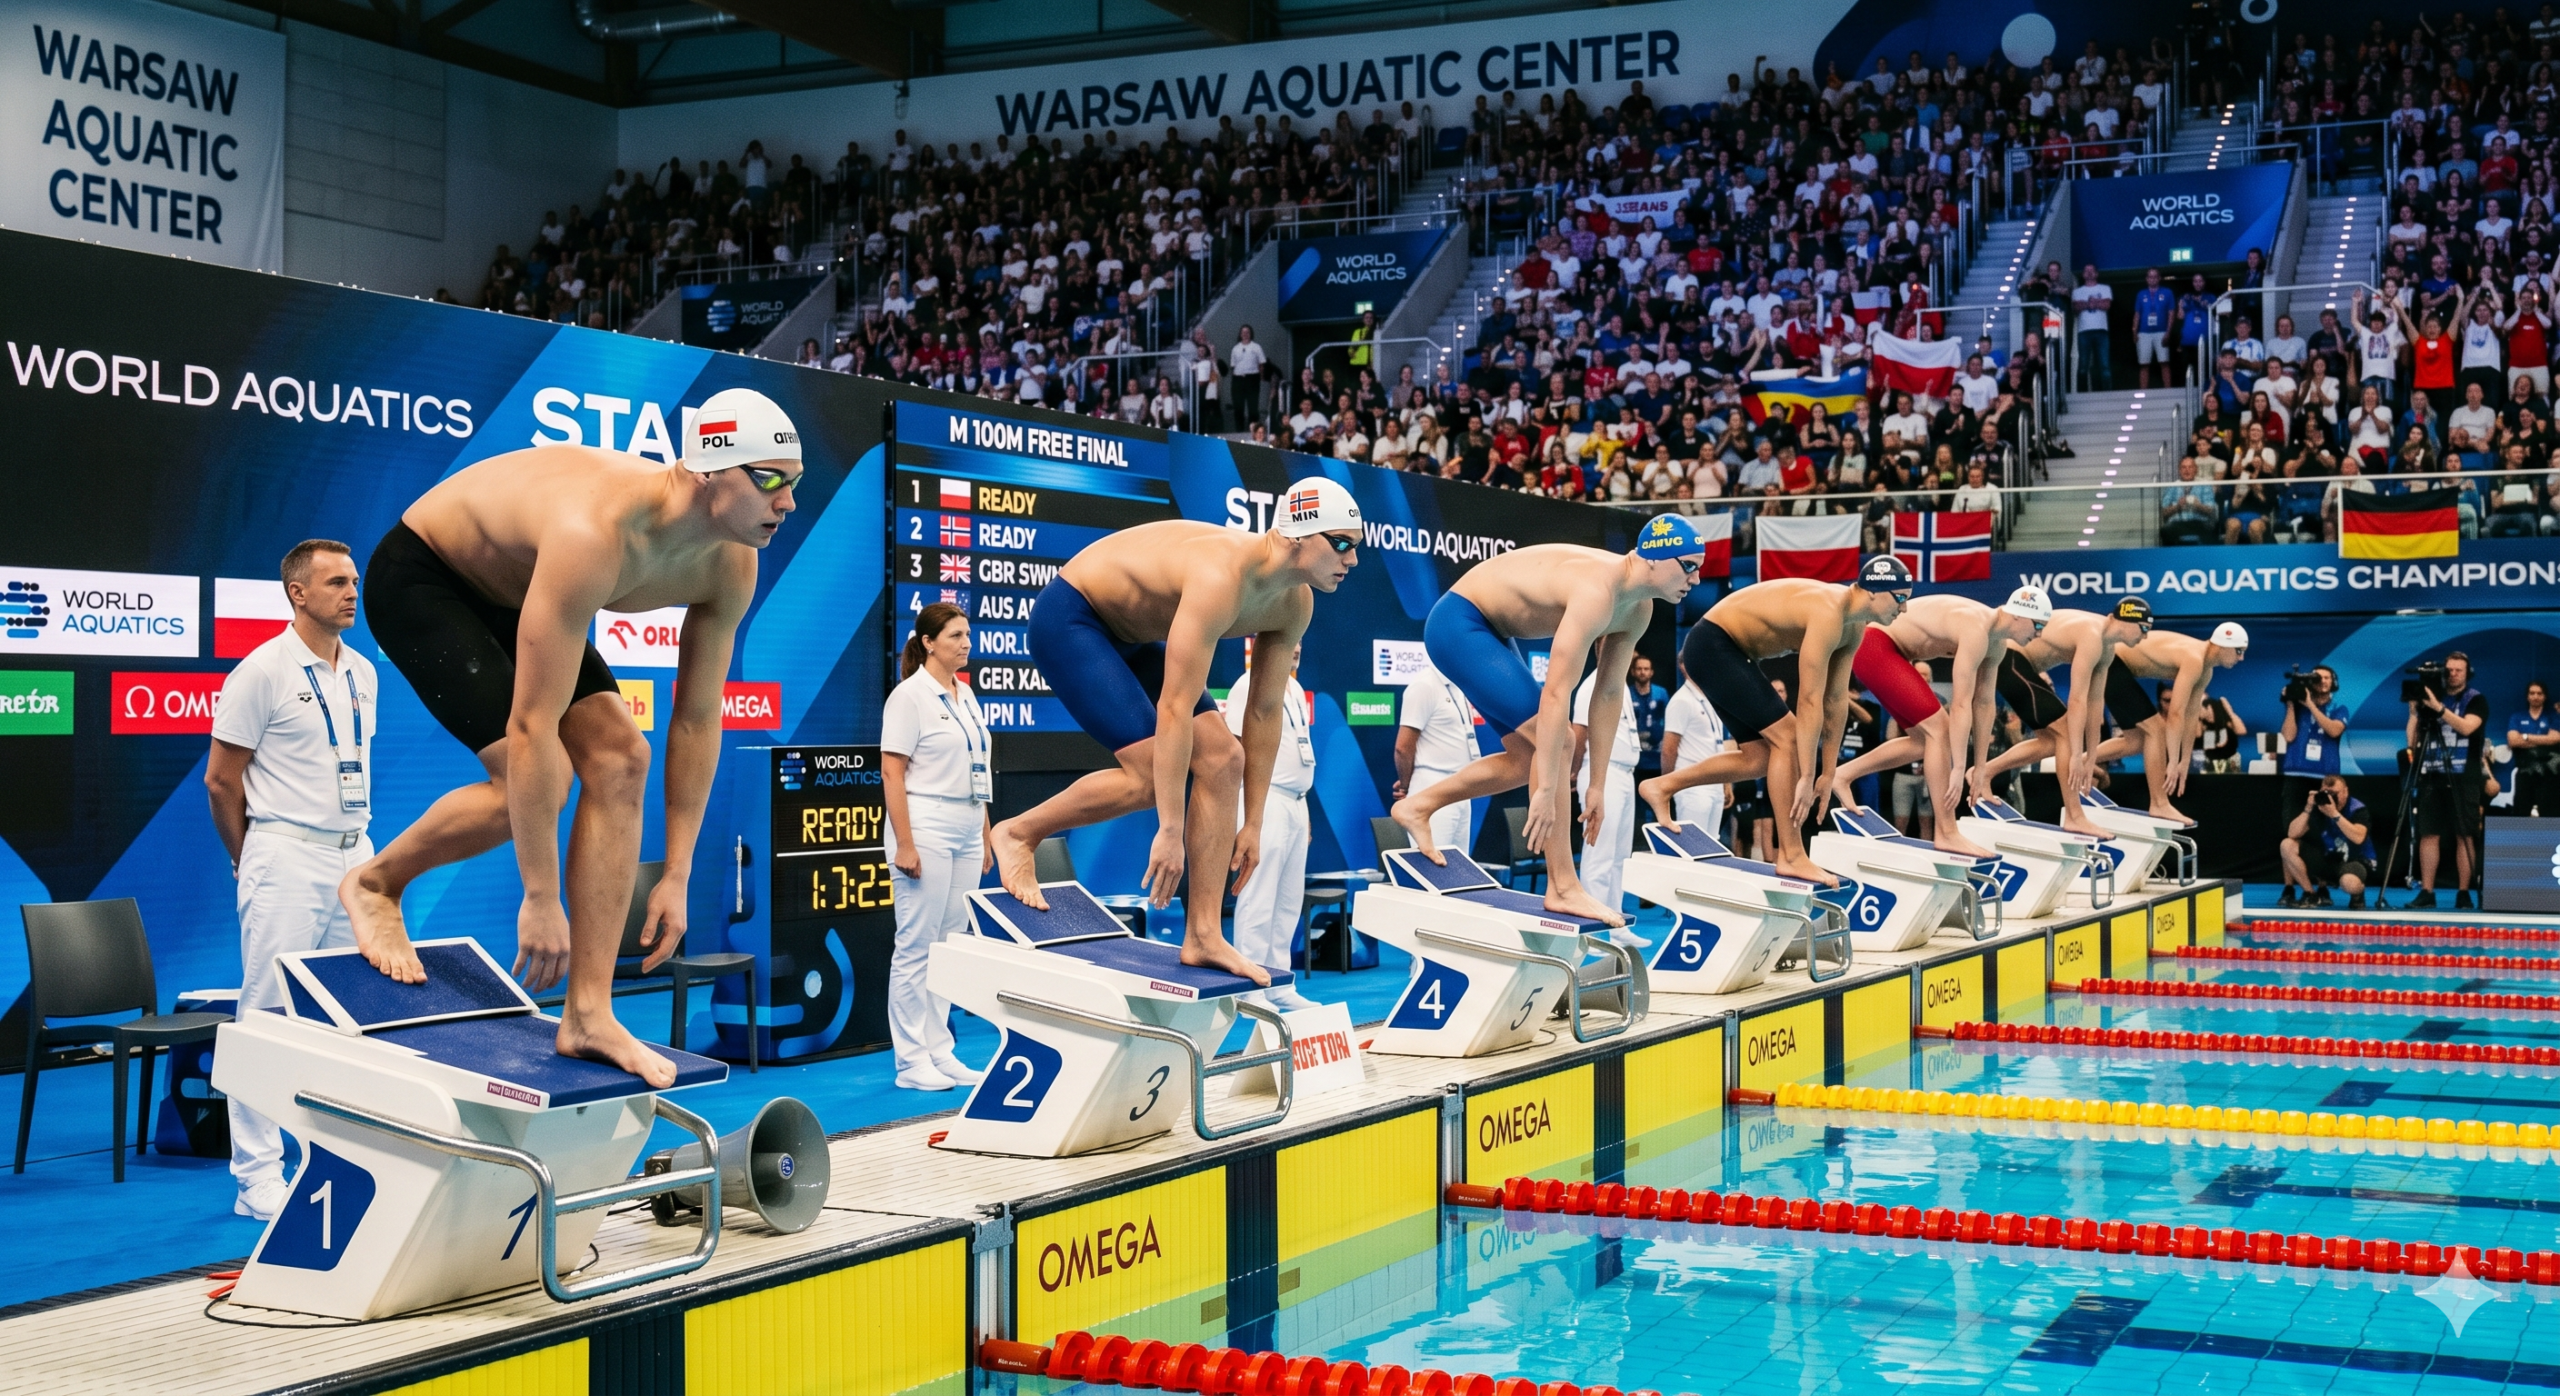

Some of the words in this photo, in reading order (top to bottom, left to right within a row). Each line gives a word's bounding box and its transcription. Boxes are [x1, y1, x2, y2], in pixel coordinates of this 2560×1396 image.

[33, 24, 240, 117] WARSAW
[995, 72, 1229, 136] WARSAW
[1243, 48, 1462, 119] AQUATIC
[1477, 28, 1681, 93] CENTER
[42, 98, 239, 182] AQUATIC
[49, 167, 223, 244] CENTER
[2129, 207, 2235, 230] AQUATICS
[2142, 192, 2221, 212] WORLD
[1326, 266, 1407, 285] AQUATICS
[1336, 252, 1396, 268] WORLD
[741, 300, 784, 313] WORLD
[7, 341, 219, 406] WORLD
[231, 371, 474, 439] AQUATICS
[702, 435, 734, 449] POL
[950, 415, 968, 444] M
[973, 418, 1023, 453] 100M
[1027, 428, 1074, 460] FREE
[1077, 434, 1129, 468] FINAL
[911, 479, 920, 503] 1
[979, 486, 1037, 515] READY
[910, 516, 923, 540] 2
[979, 522, 1037, 551] READY
[1292, 510, 1319, 523] MIN
[1363, 521, 1431, 554] WORLD
[1433, 531, 1517, 563] AQUATICS
[910, 553, 923, 578] 3
[979, 559, 1015, 584] GBR
[2020, 570, 2150, 596] WORLD
[2156, 565, 2340, 594] AQUATICS
[2347, 561, 2560, 590] CHAMPION
[62, 588, 154, 611] WORLD
[910, 591, 923, 616] 4
[979, 595, 1014, 620] AUS
[62, 613, 185, 636] AQUATICS
[979, 666, 1015, 690] GER
[1020, 703, 1035, 726] N.
[814, 755, 864, 769] WORLD
[814, 771, 882, 787] AQUATICS
[803, 806, 882, 843] READY
[1860, 895, 1880, 926] 6
[1679, 929, 1702, 964] 5
[1752, 936, 1781, 973] 5
[1418, 979, 1446, 1020] 4
[1510, 986, 1543, 1031] 5
[1927, 976, 1962, 1009] OMEGA
[1748, 1025, 1797, 1067] OMEGA
[1003, 1055, 1034, 1109] 2
[1130, 1065, 1171, 1122] 3
[1479, 1097, 1552, 1153] OMEGA
[309, 1179, 333, 1250] 1
[501, 1193, 536, 1262] 1
[1038, 1214, 1162, 1294] OMEGA
